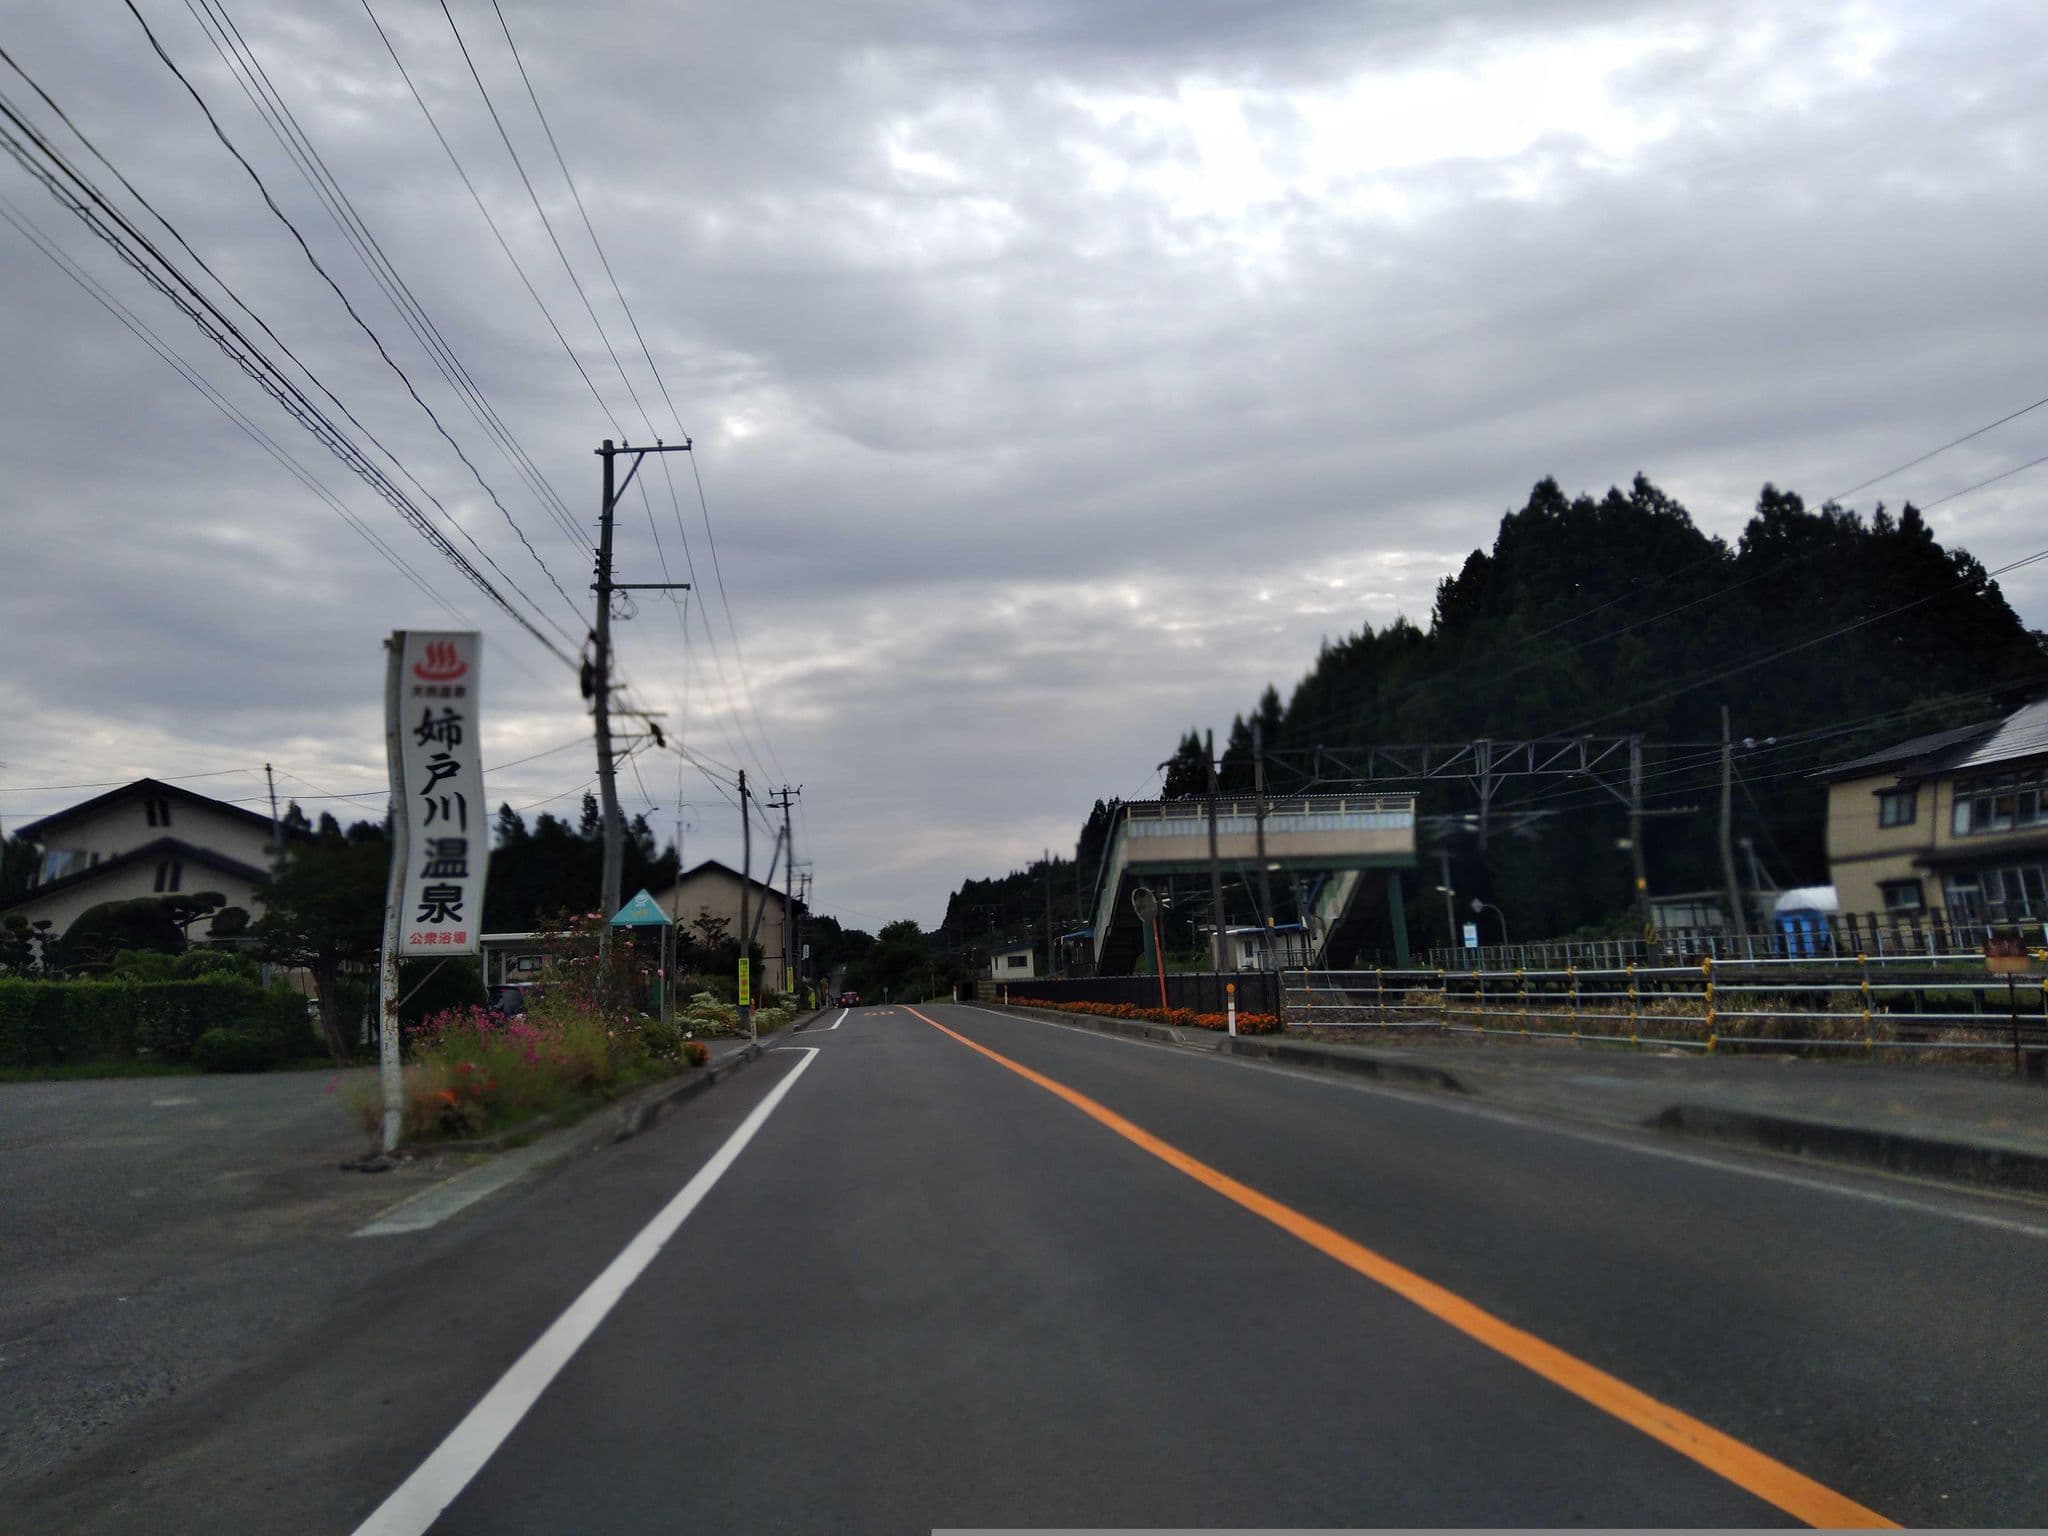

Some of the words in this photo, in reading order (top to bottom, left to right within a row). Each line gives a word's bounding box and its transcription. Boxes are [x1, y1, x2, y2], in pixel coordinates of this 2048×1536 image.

[413, 706, 469, 924] 姉戸川温泉
[409, 931, 467, 945] 公衆浴場
